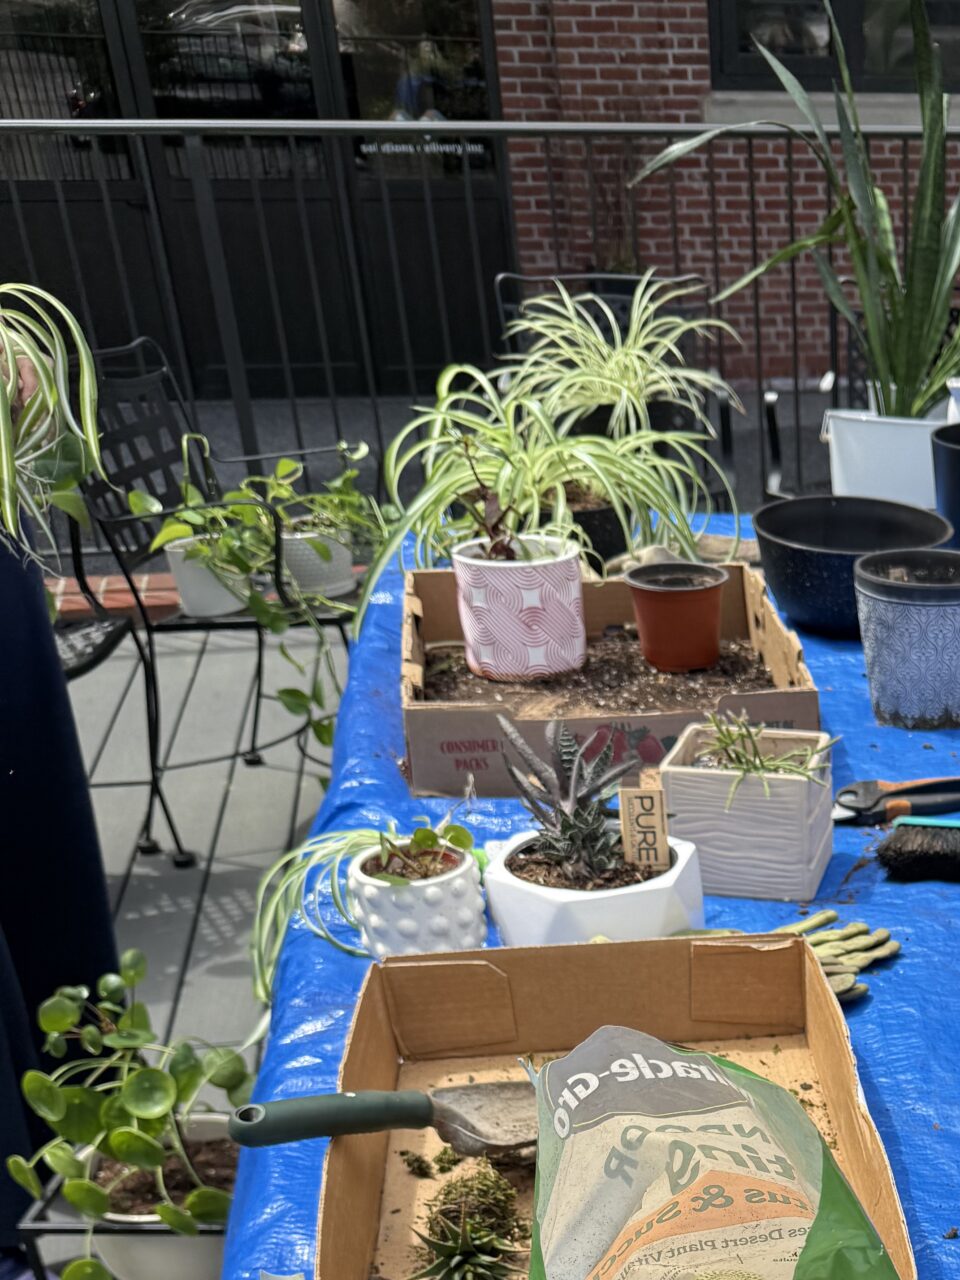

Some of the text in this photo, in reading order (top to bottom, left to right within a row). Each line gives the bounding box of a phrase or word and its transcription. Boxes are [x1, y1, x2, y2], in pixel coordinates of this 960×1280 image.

[440, 739, 498, 753] CONSUMER
[455, 757, 489, 771] PACKS
[634, 795, 660, 863] PURE
